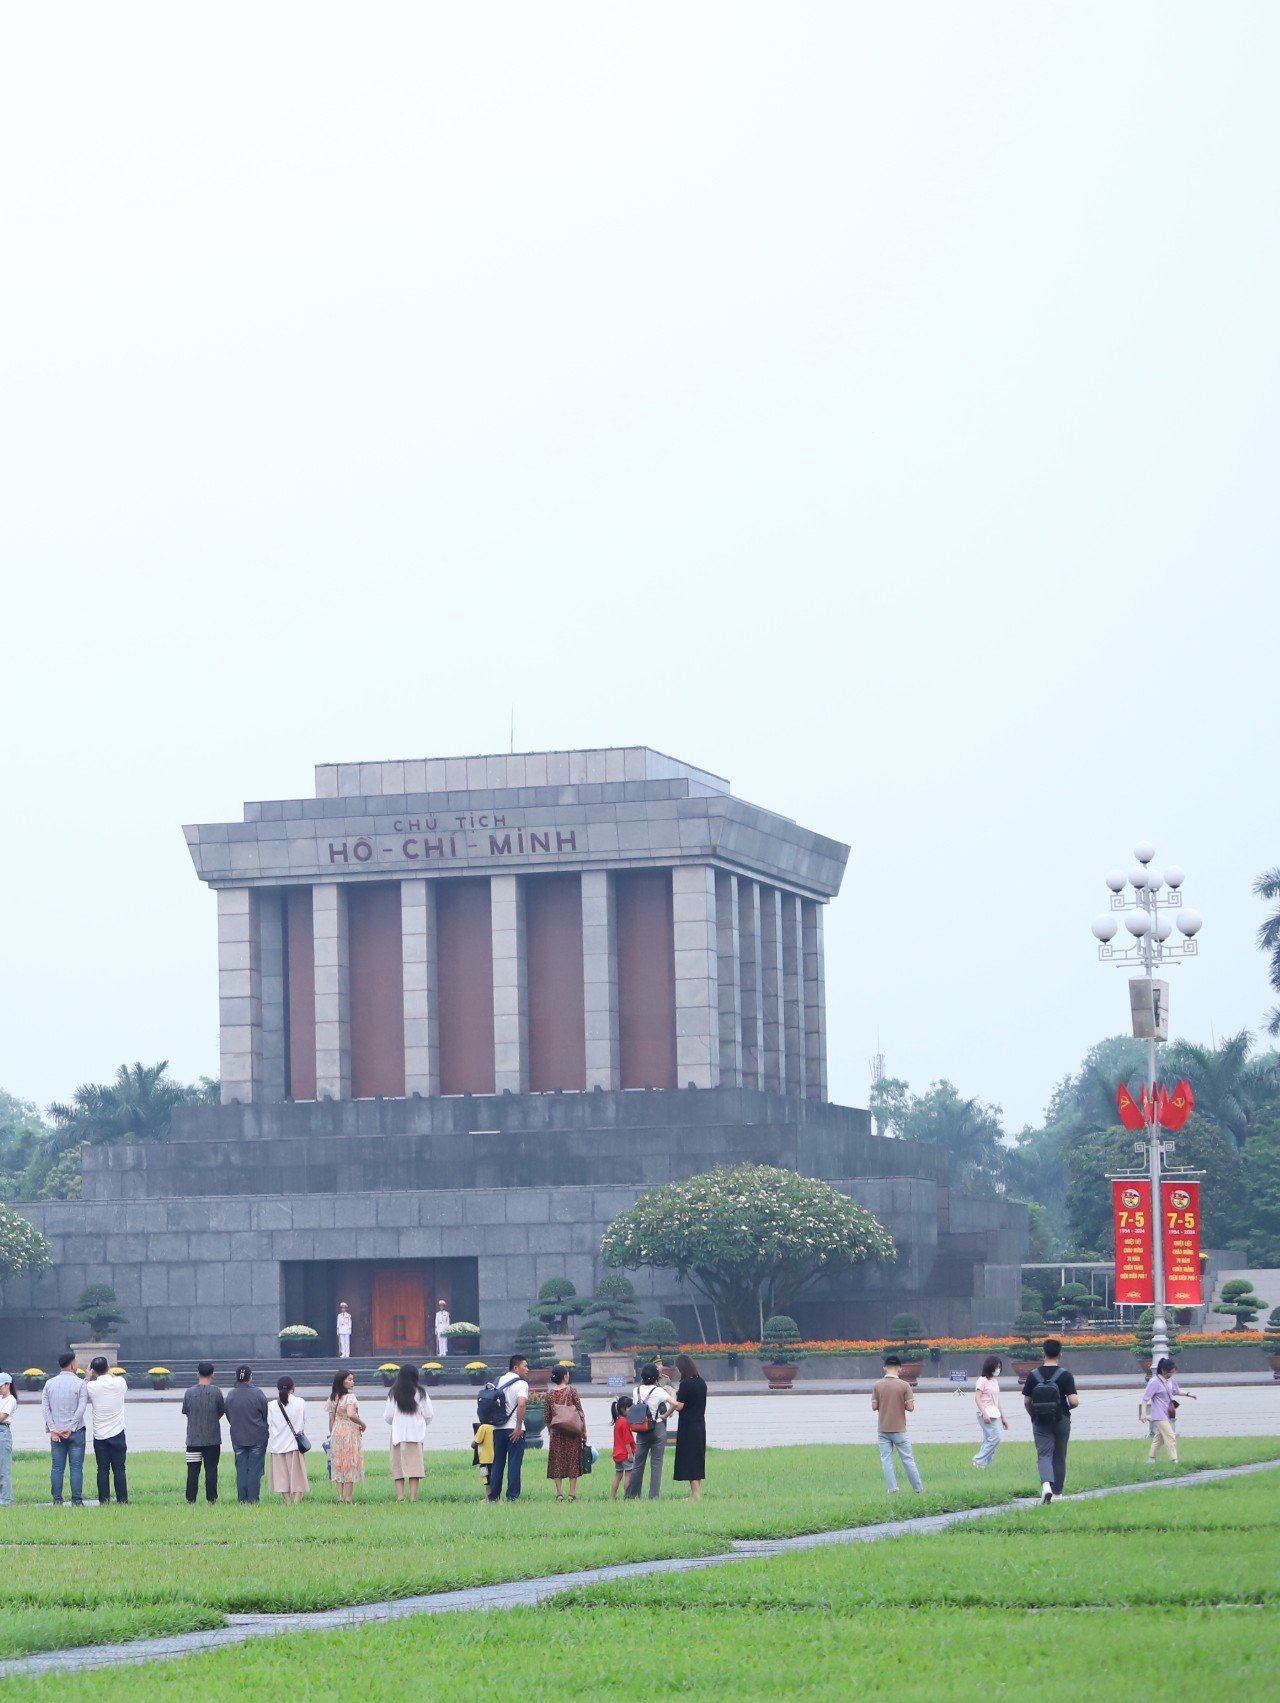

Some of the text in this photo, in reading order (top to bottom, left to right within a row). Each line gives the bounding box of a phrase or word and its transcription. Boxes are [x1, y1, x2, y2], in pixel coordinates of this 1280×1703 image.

[393, 812, 506, 833] CHỦ TỊCH
[328, 836, 374, 863] HỒ
[402, 832, 457, 860] CHÍ
[488, 827, 577, 856] MINH
[1118, 1212, 1145, 1228] 7-5
[1167, 1212, 1195, 1228] 7-5
